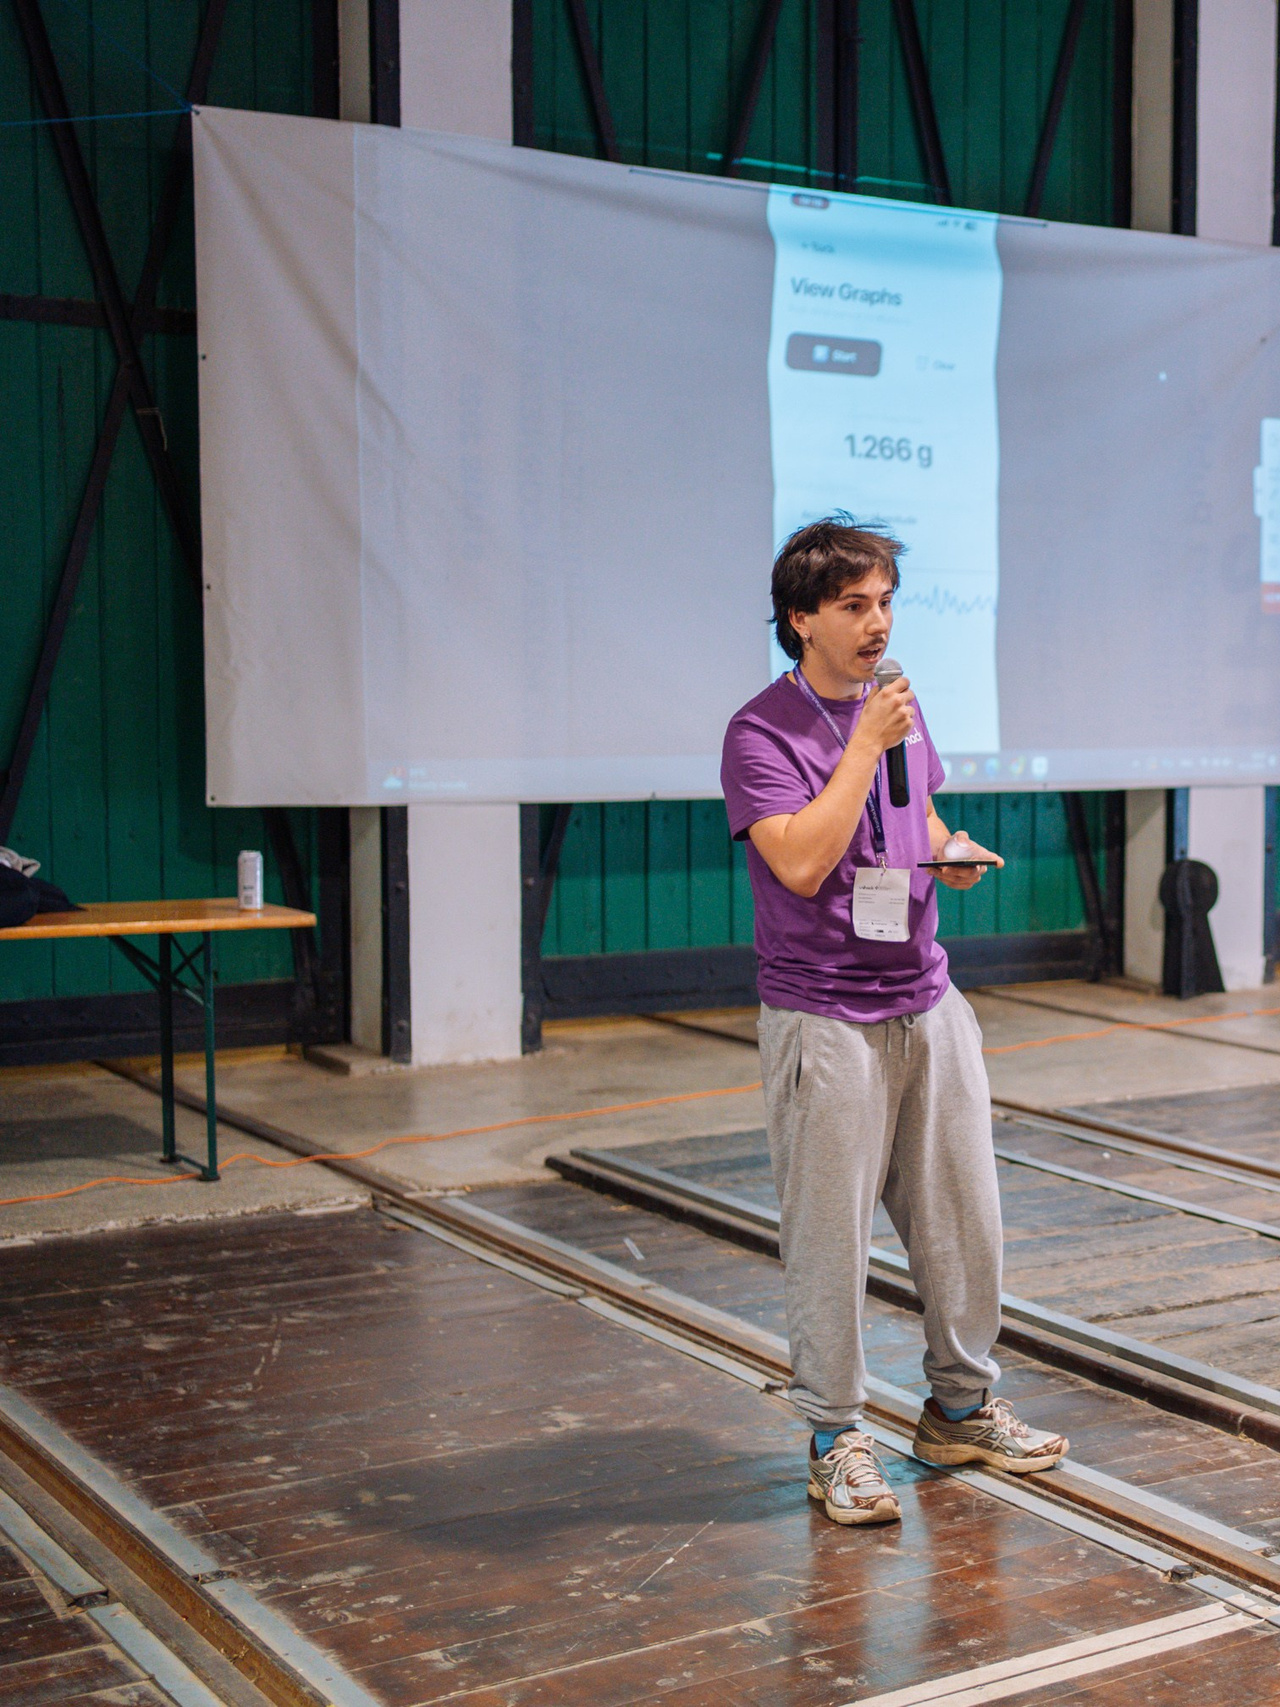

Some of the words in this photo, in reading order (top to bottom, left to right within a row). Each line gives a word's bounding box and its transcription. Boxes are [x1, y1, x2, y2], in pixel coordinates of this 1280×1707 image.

[790, 276, 835, 299] View
[838, 282, 903, 306] Graphs
[844, 433, 913, 462] 1.266
[917, 443, 933, 469] g
